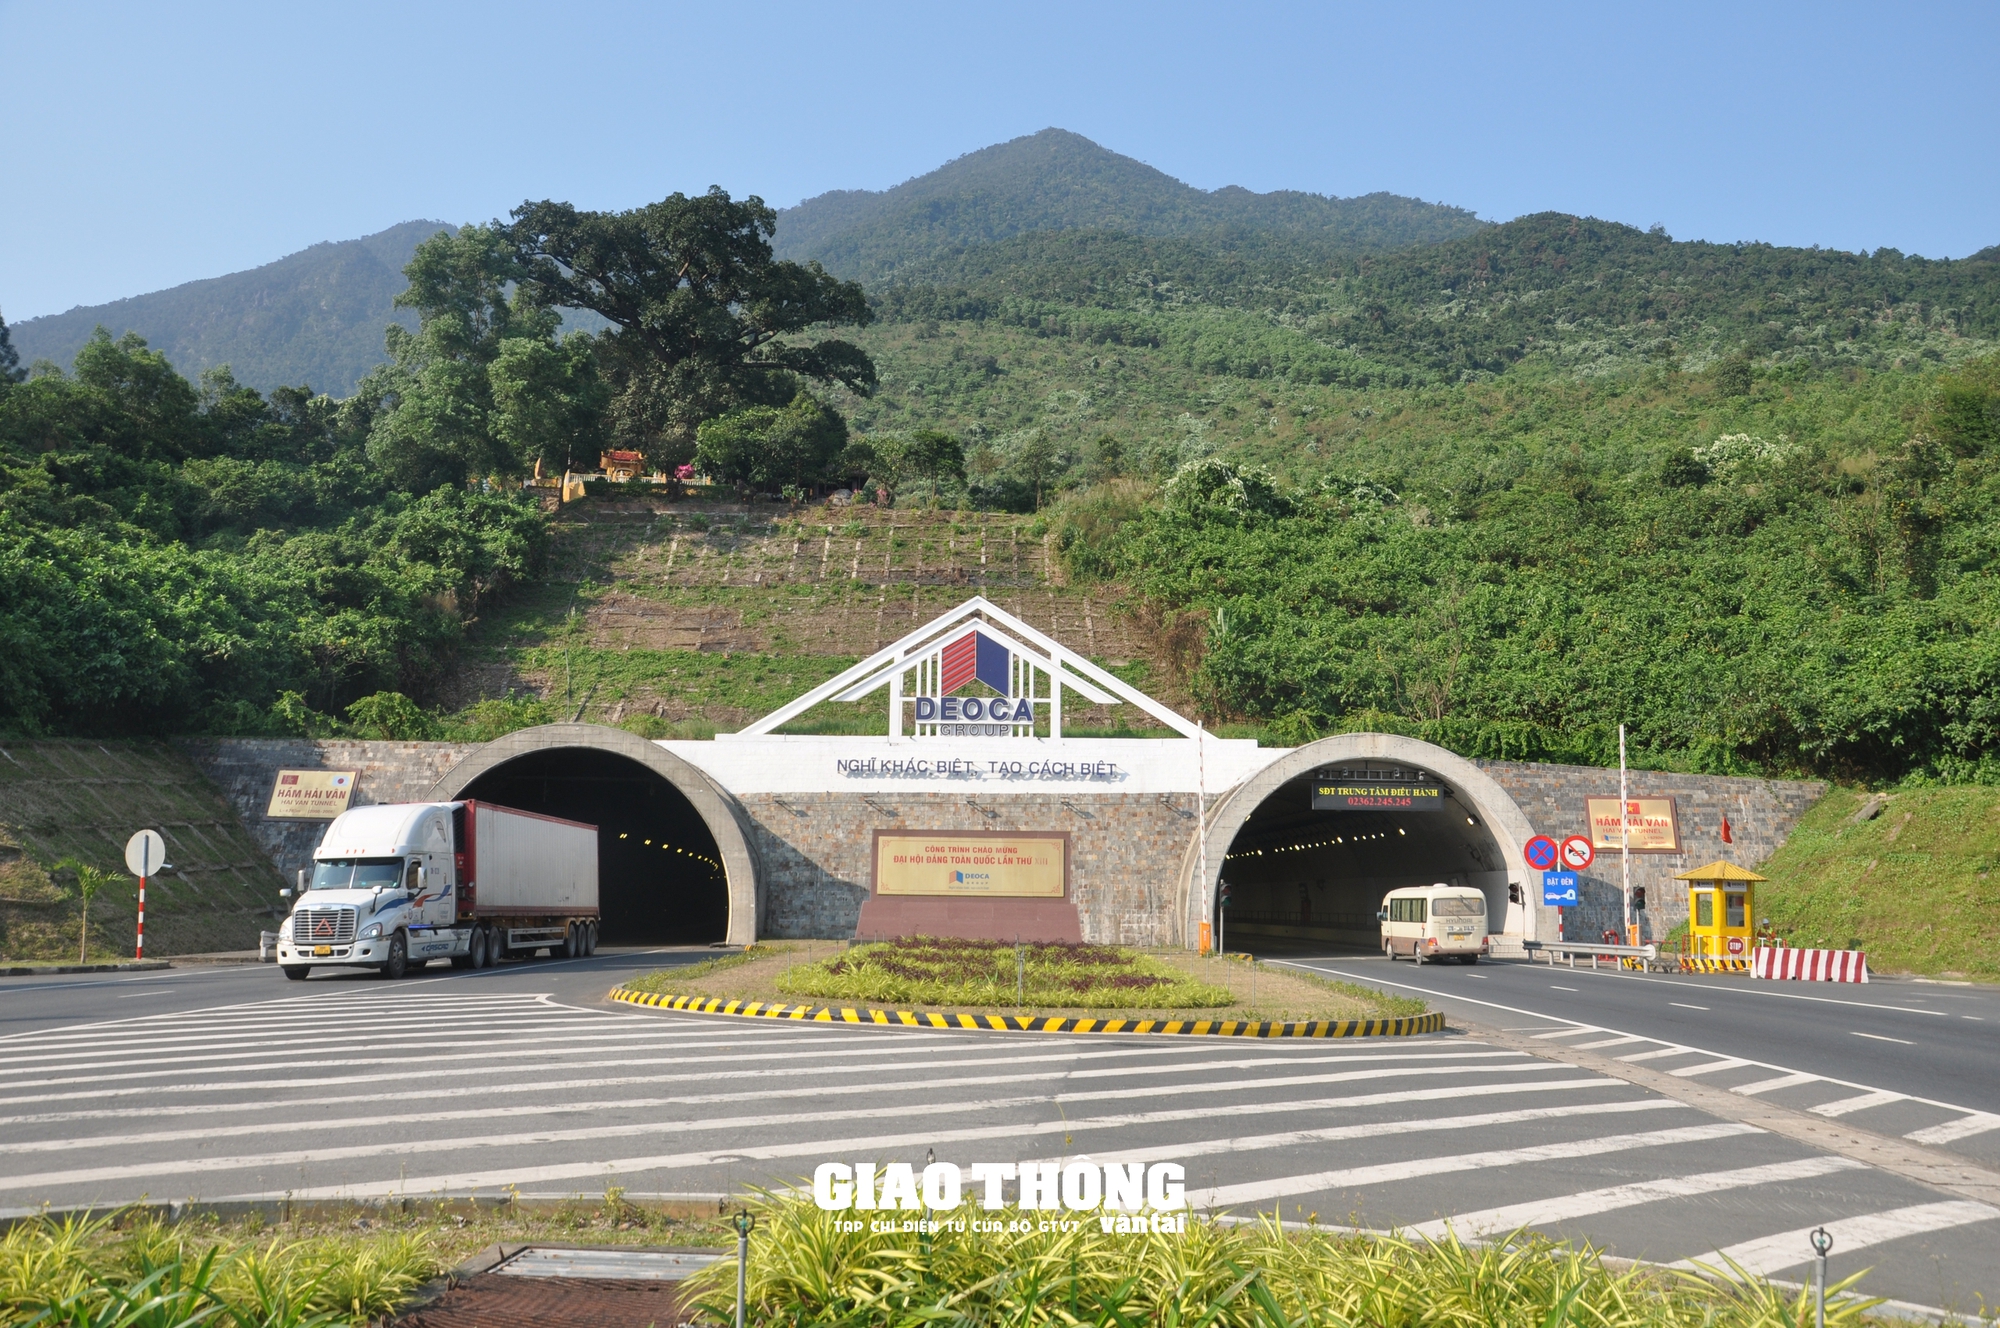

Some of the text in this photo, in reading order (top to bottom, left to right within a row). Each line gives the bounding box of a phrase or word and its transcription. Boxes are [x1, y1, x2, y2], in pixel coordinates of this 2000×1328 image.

[916, 697, 1033, 722] DEOCA
[940, 724, 1010, 737] GROUP
[837, 757, 876, 772] NGHĨ
[881, 757, 928, 773] KHÁC
[988, 761, 1022, 776] TẠO
[1029, 759, 1075, 775] CÁCH
[1080, 760, 1117, 778] BIỆT
[304, 787, 323, 799] HẢI
[325, 788, 347, 799] VÂN
[1319, 787, 1336, 796] SĐT
[1337, 787, 1368, 796] TRUNG
[1369, 786, 1389, 796] TÂM
[1413, 787, 1438, 797] HÀNH
[1348, 797, 1412, 806] 02362.245.245
[924, 845, 945, 853] CÔNG
[948, 845, 970, 853] TRÌNH
[972, 845, 993, 853] CHÀO
[893, 855, 907, 864] ĐẠI
[910, 854, 923, 865] HỘI
[926, 854, 948, 863] ĐẢNG
[950, 855, 971, 864] TOÀN
[973, 854, 995, 865] QUỐC
[1546, 876, 1558, 887] BẬT
[1729, 942, 1742, 950] STOP
